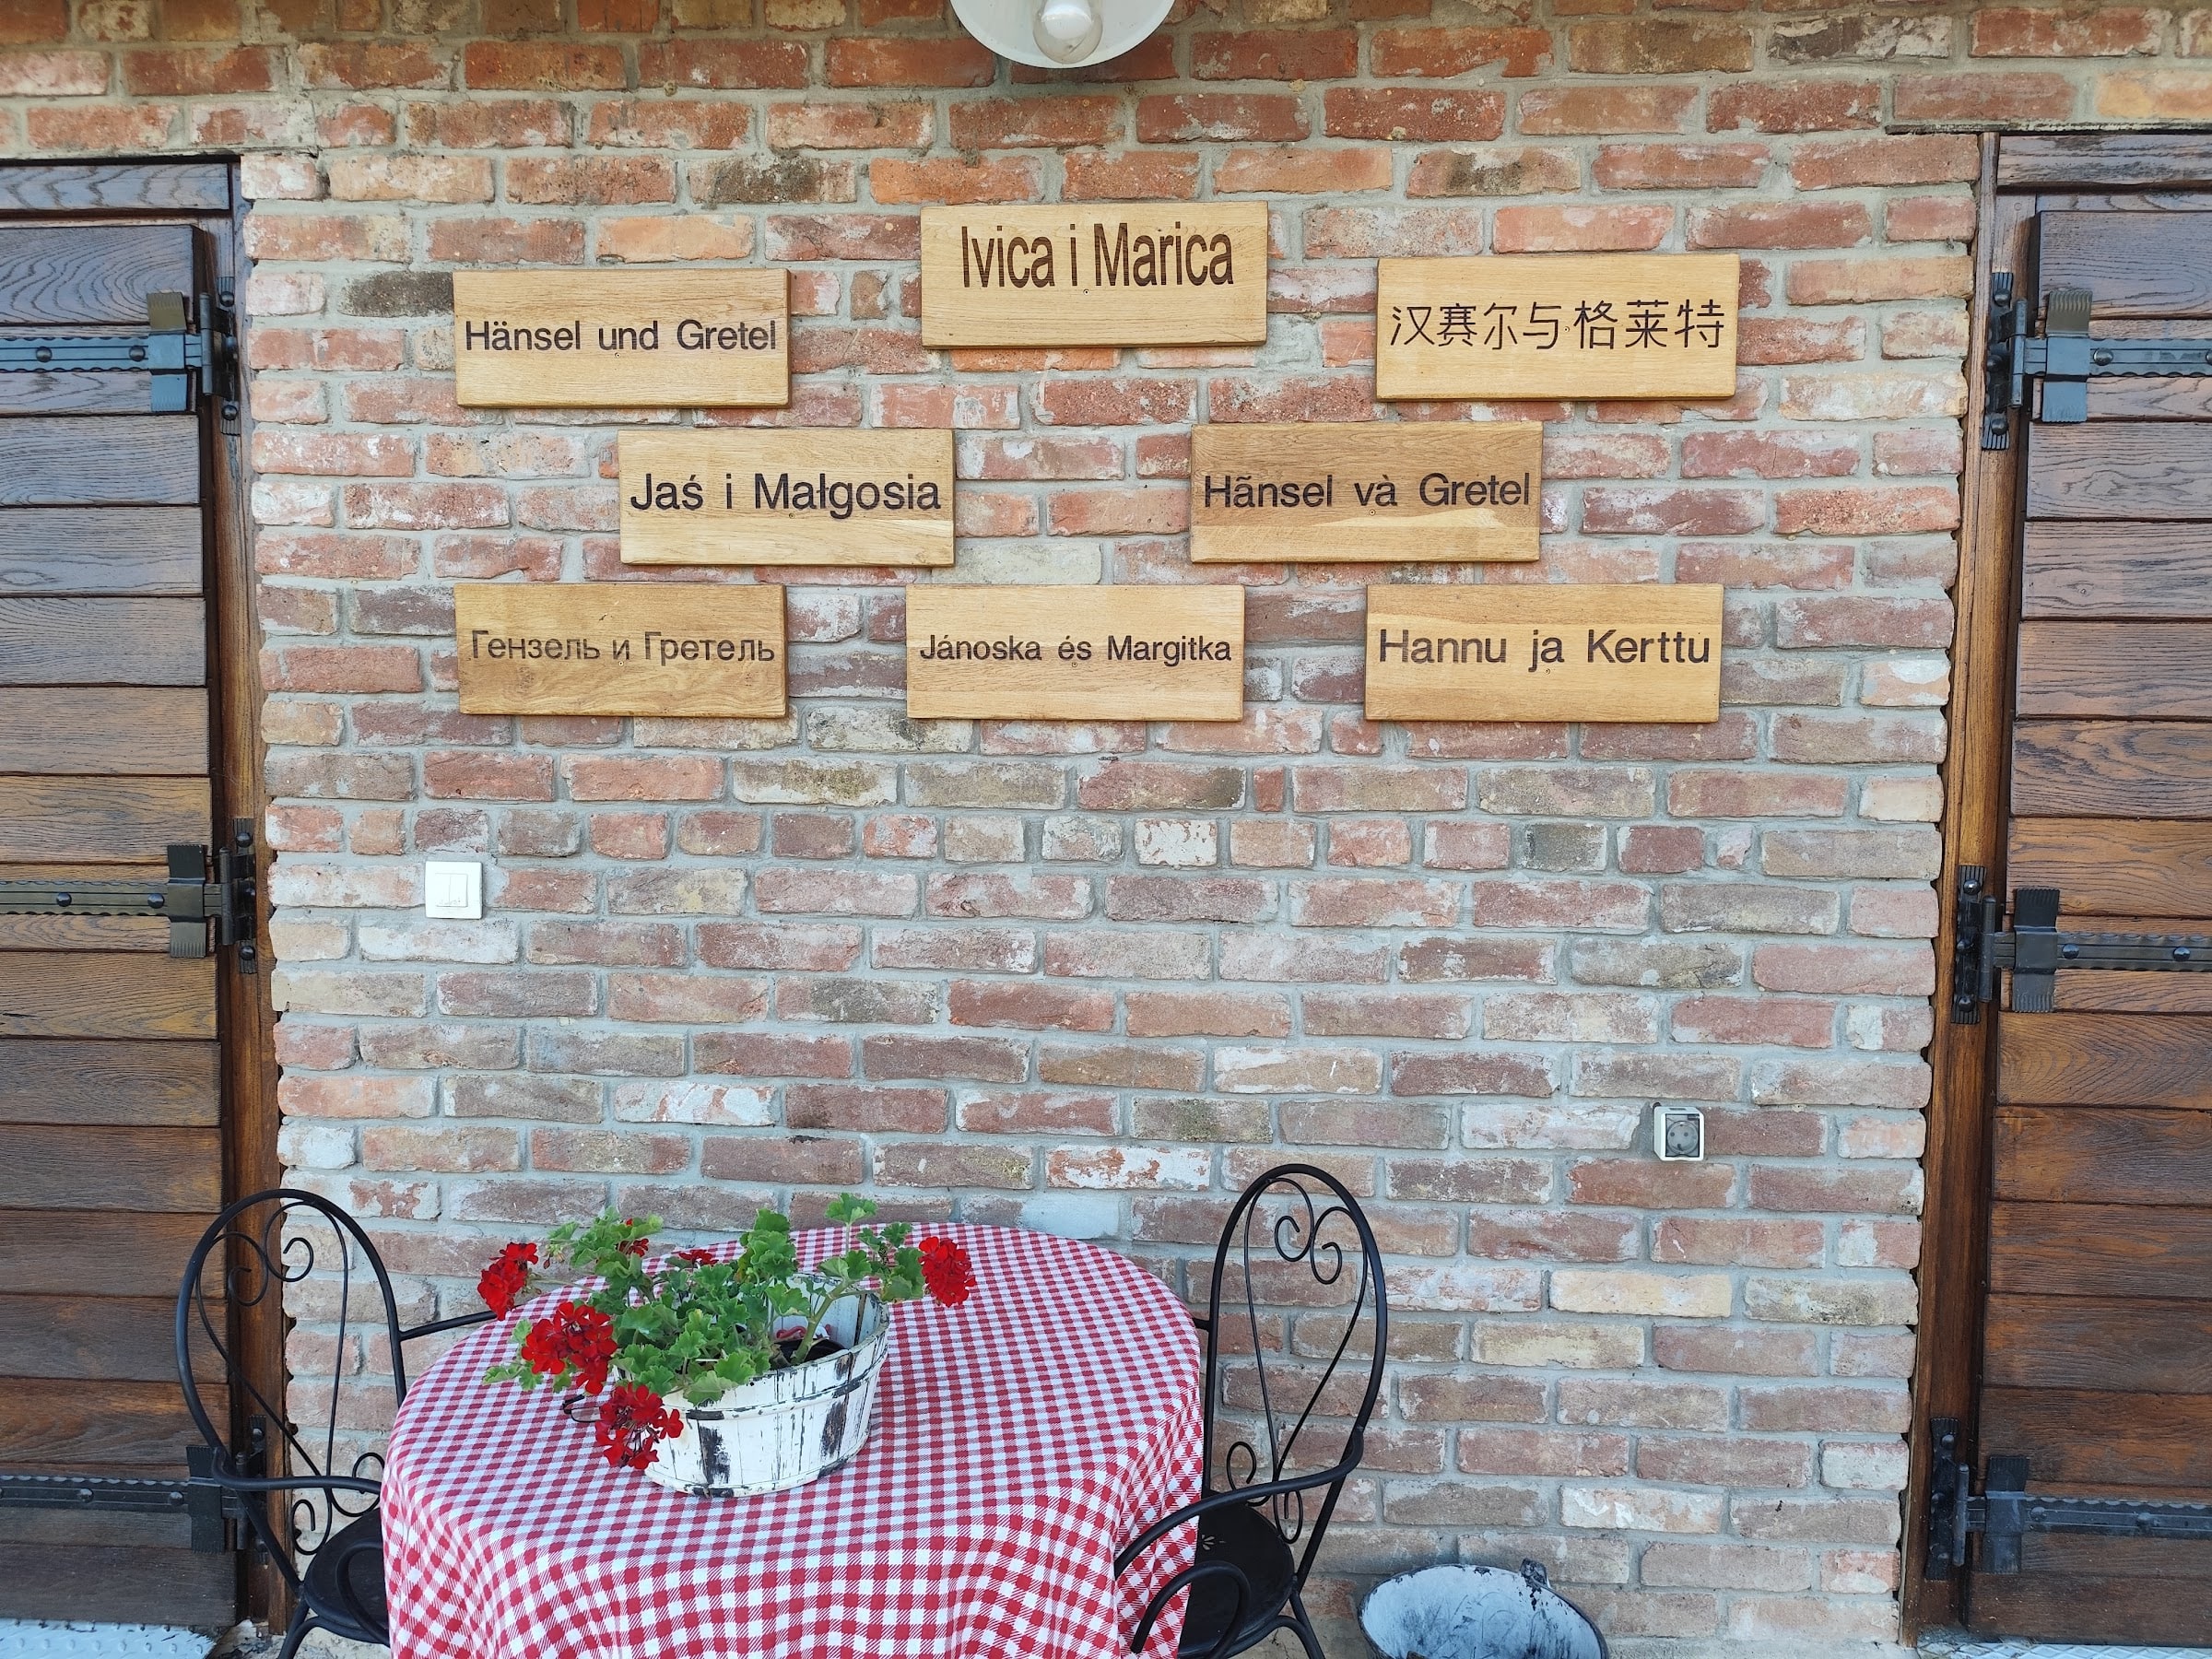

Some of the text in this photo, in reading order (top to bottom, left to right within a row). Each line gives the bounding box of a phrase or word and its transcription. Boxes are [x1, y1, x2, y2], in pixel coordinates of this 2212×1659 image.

[961, 221, 1234, 288] Ivica i Marica
[465, 319, 777, 351] Hänsel und Gretel
[1390, 299, 1725, 350] 汉赛尔与格莱特
[630, 472, 942, 521] Jaś i Małgosia
[1205, 473, 1530, 509] Hãnsel và Gretel
[472, 629, 775, 666] Гензель и Гретель
[920, 634, 1232, 667] Jánoska és Margitka
[1379, 629, 1711, 673] Hannu ja Kerttu
